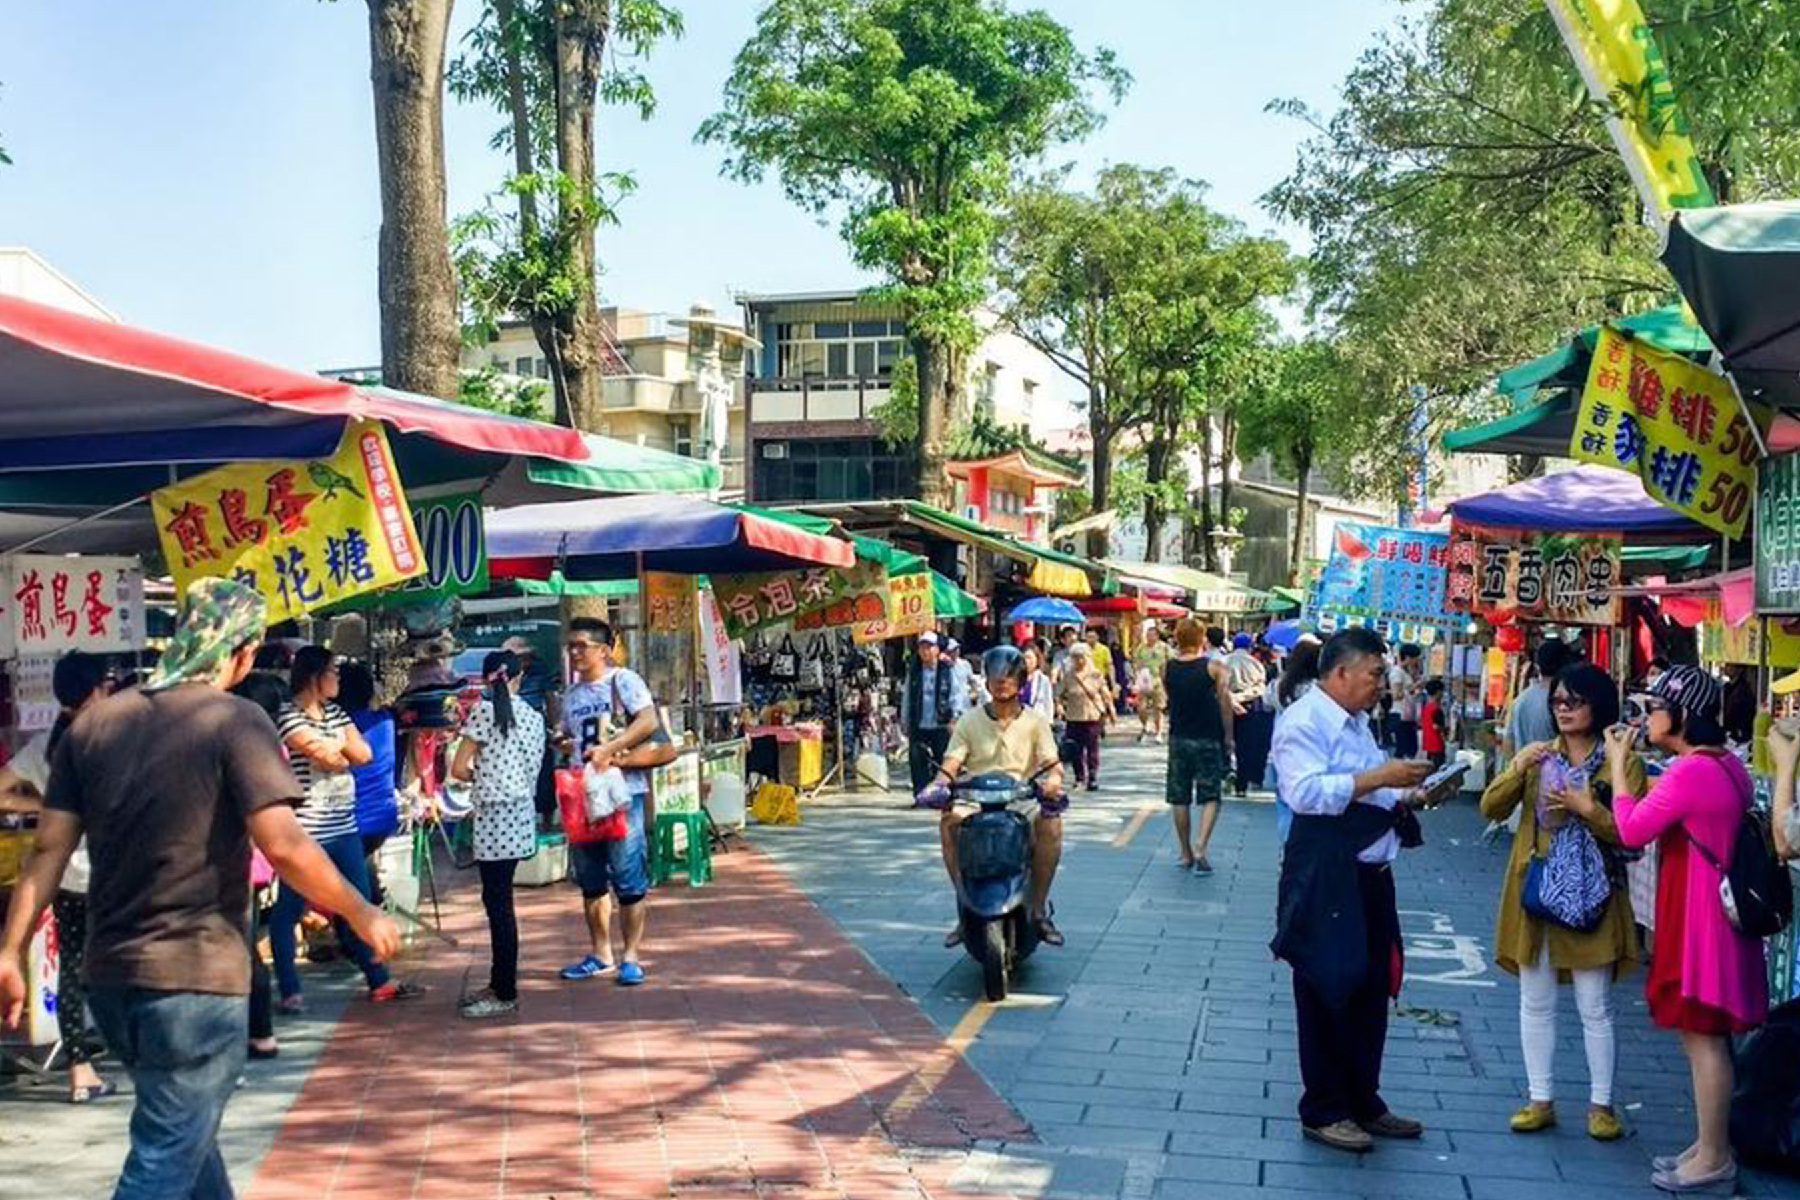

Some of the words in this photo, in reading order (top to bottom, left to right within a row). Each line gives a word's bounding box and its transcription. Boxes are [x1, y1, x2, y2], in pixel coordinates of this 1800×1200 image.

[1719, 412, 1759, 467] 50
[165, 467, 320, 569] 煎鳥蛋
[1700, 472, 1750, 535] 50
[15, 568, 113, 640] 煎鳥蛋
[900, 594, 922, 616] 10
[1478, 544, 1614, 611] 五香肉串
